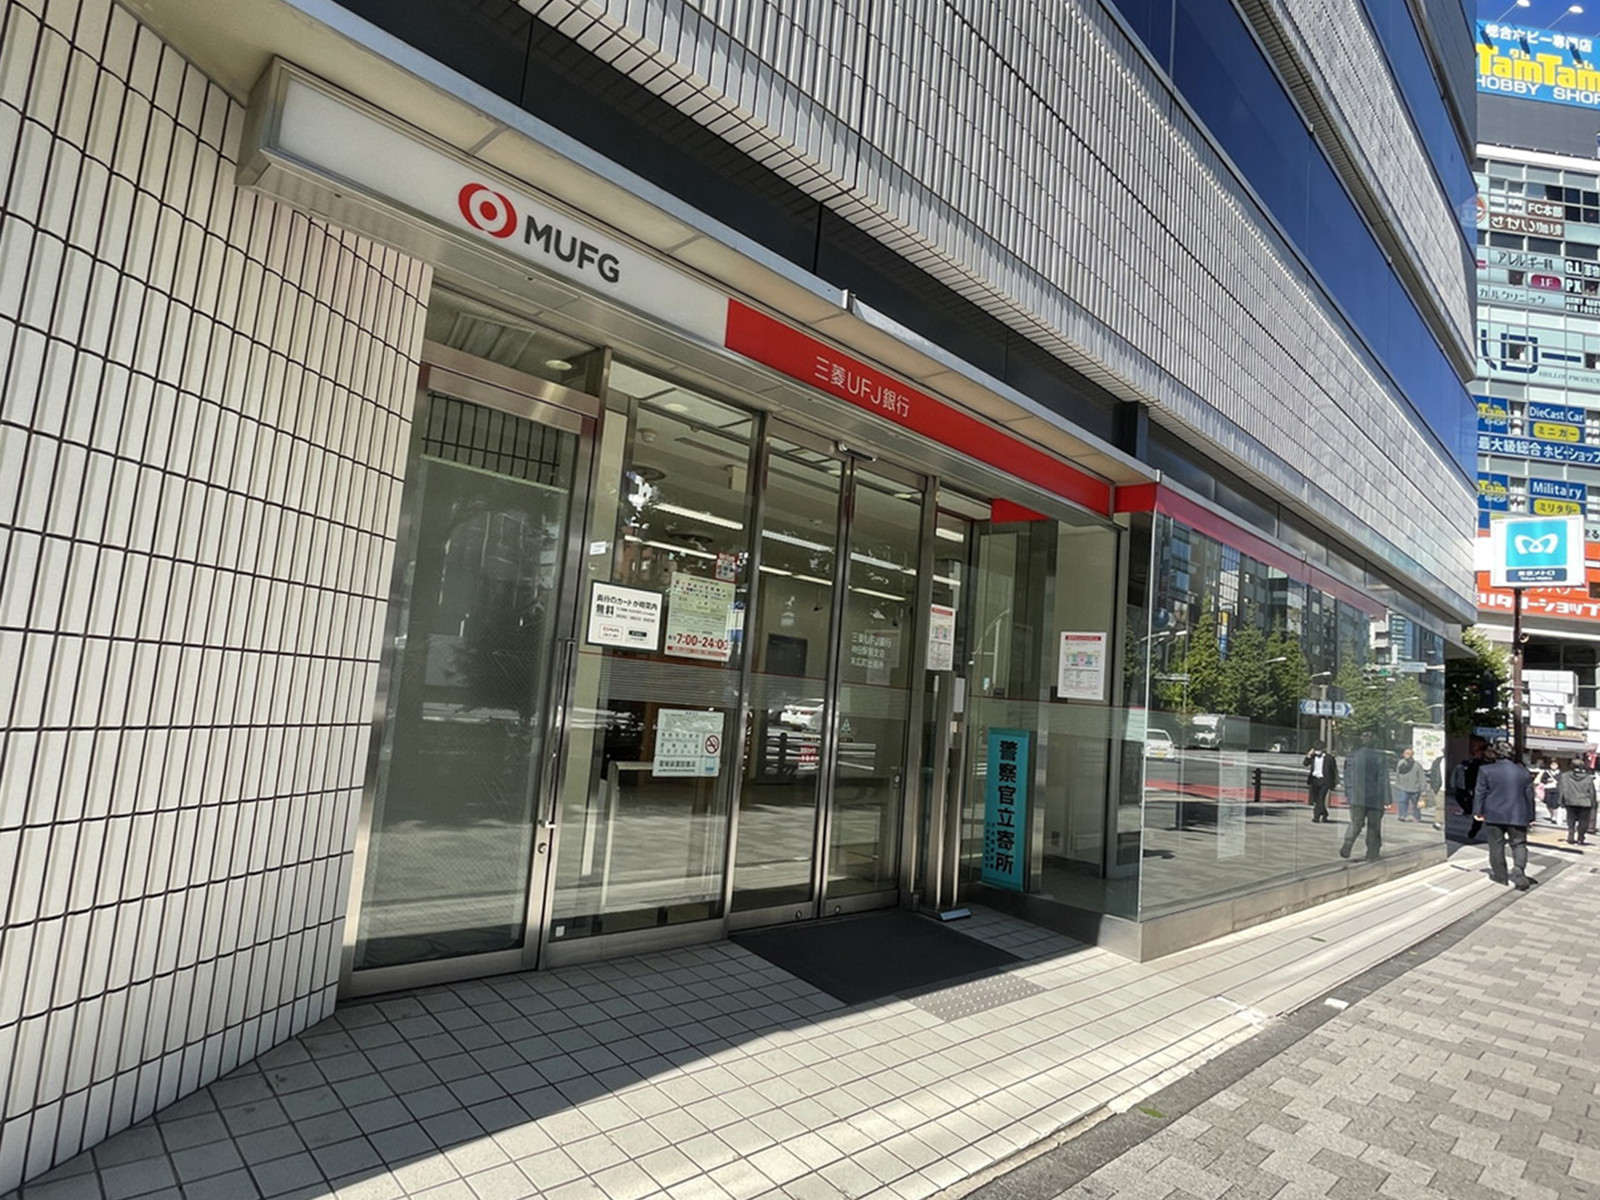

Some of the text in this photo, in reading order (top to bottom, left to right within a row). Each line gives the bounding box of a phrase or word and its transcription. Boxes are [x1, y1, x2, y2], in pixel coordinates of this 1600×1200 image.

[1476, 44, 1600, 92] TamTam
[524, 215, 620, 284] MUFG
[1540, 277, 1553, 287] 1F
[1566, 279, 1582, 294] PX
[814, 355, 910, 418] 三菱UFJ銀行
[1529, 406, 1584, 422] DieCast Car
[1538, 426, 1577, 438] ミニカー
[1532, 481, 1583, 500] Military
[1477, 593, 1600, 617] リターショップ
[995, 740, 1018, 875] 警察官立寄所
